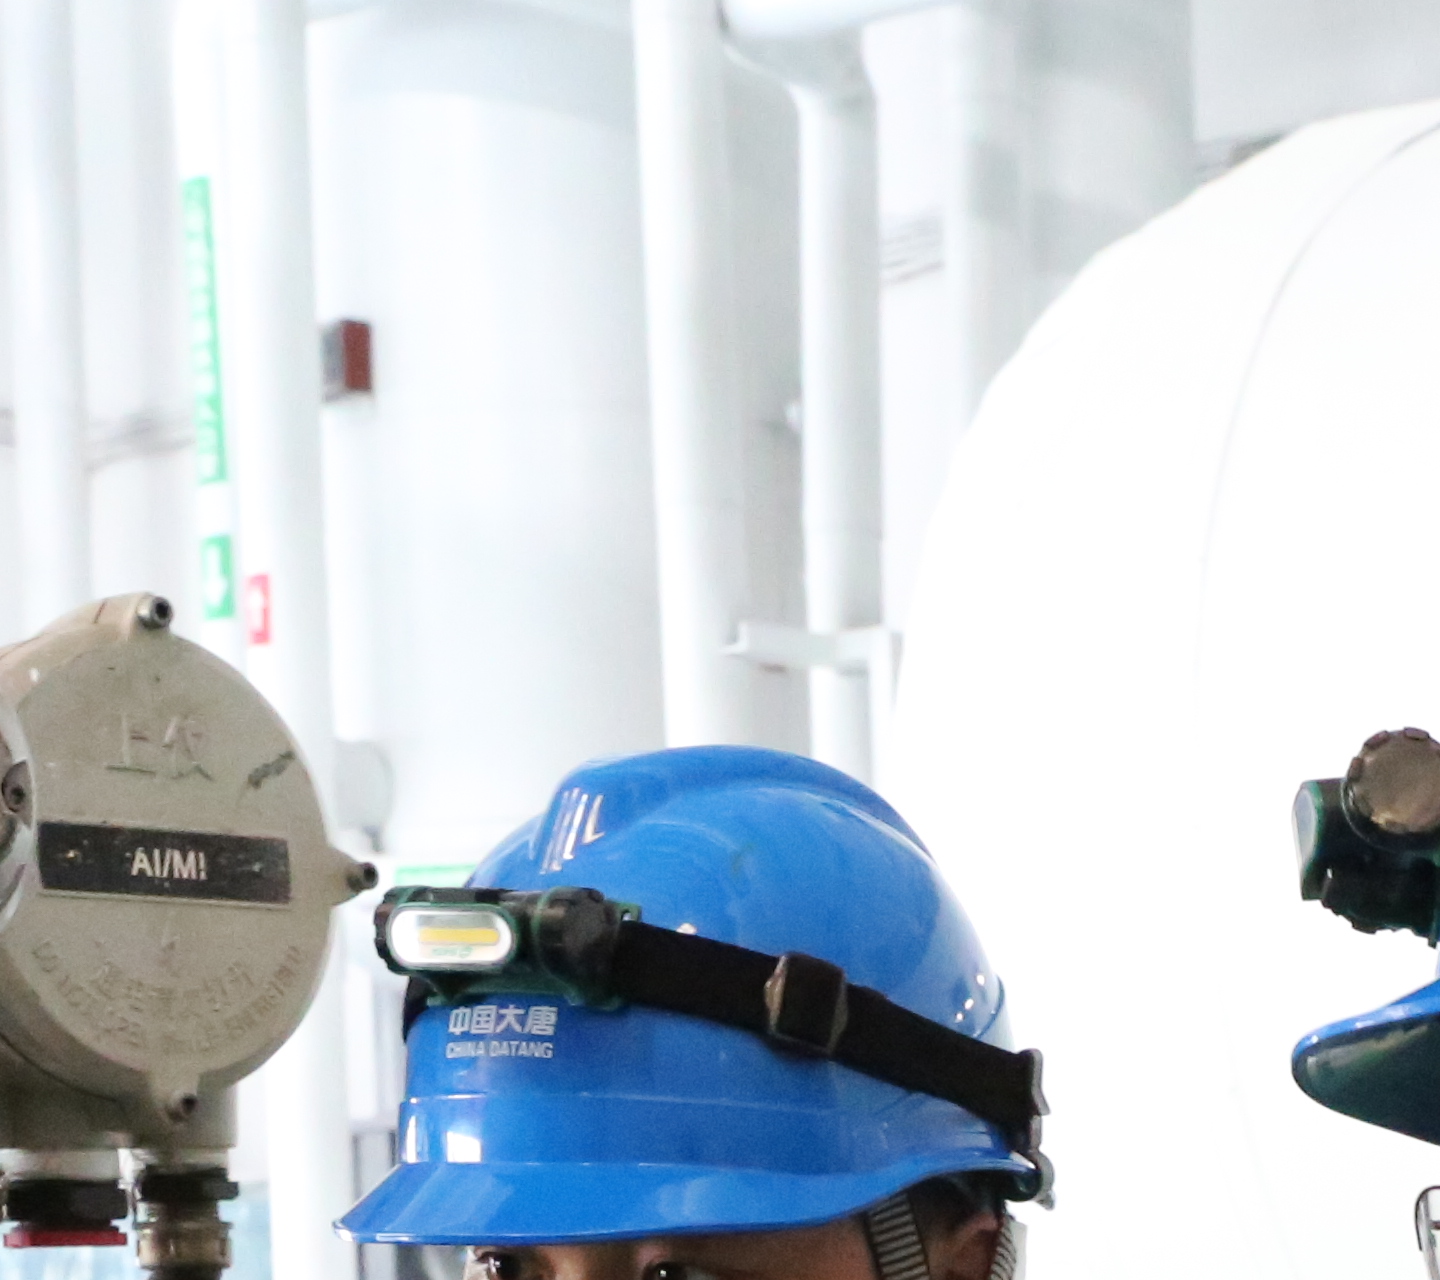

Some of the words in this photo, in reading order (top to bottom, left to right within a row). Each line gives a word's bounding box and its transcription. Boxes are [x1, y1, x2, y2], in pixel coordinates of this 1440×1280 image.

[448, 1003, 558, 1036] 中国大唐
[446, 1040, 485, 1058] CHINA
[488, 1040, 554, 1059] DATANG
